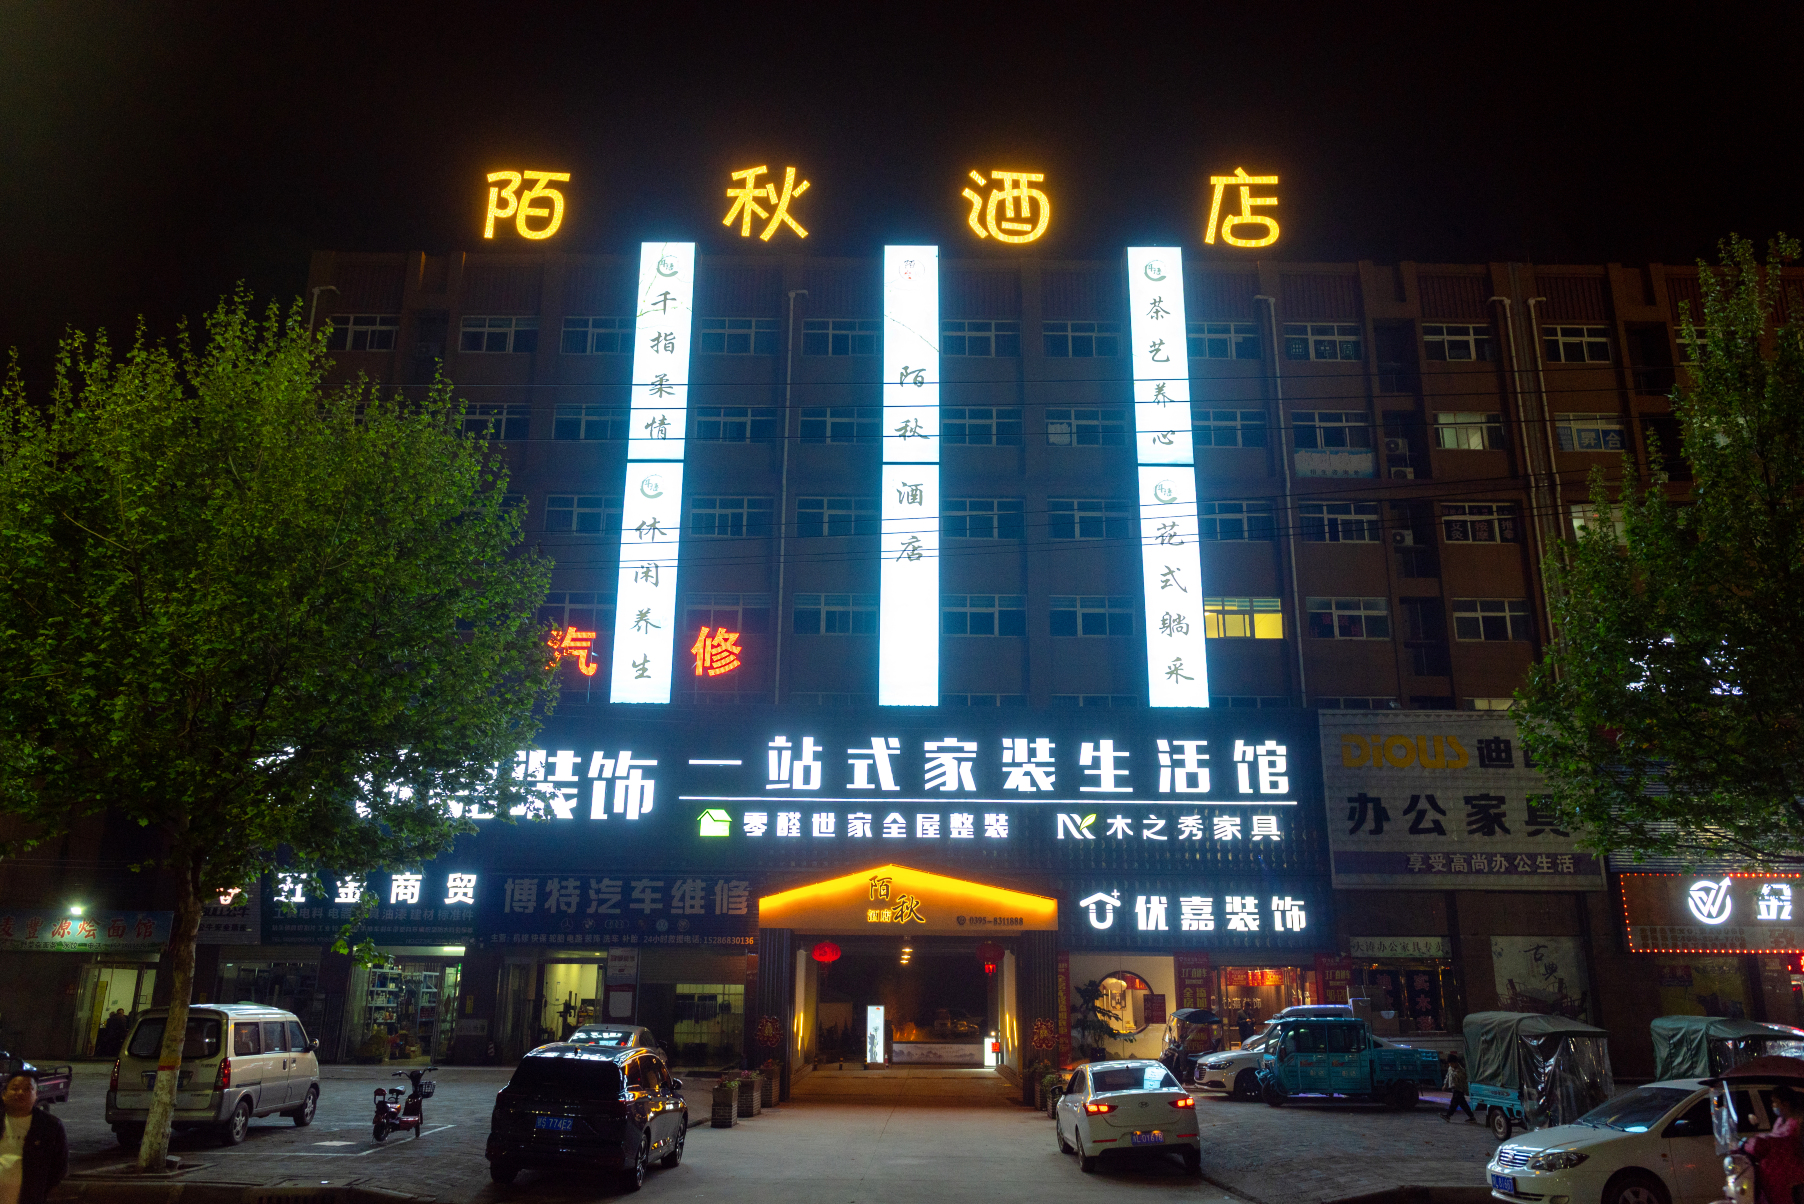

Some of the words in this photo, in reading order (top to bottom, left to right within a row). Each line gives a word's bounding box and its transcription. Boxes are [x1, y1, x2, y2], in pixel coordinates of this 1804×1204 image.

[484, 164, 1280, 248] 陌秋酒店
[645, 290, 676, 440] 千指柔情
[1147, 296, 1175, 445] 茶艺养心
[894, 365, 930, 562] 陌秋酒店
[630, 517, 667, 680] 休闲养生
[688, 735, 1290, 794] 一站式家装生活馆
[743, 812, 1010, 839] 零醛世家全屋整装
[1106, 814, 1282, 841] 木之秀家具
[1347, 793, 1572, 838] 办公家具
[1407, 854, 1576, 874] 享受高尚办公生活
[503, 877, 751, 915] 博特汽车维修
[1134, 895, 1307, 932] 优嘉装饰
